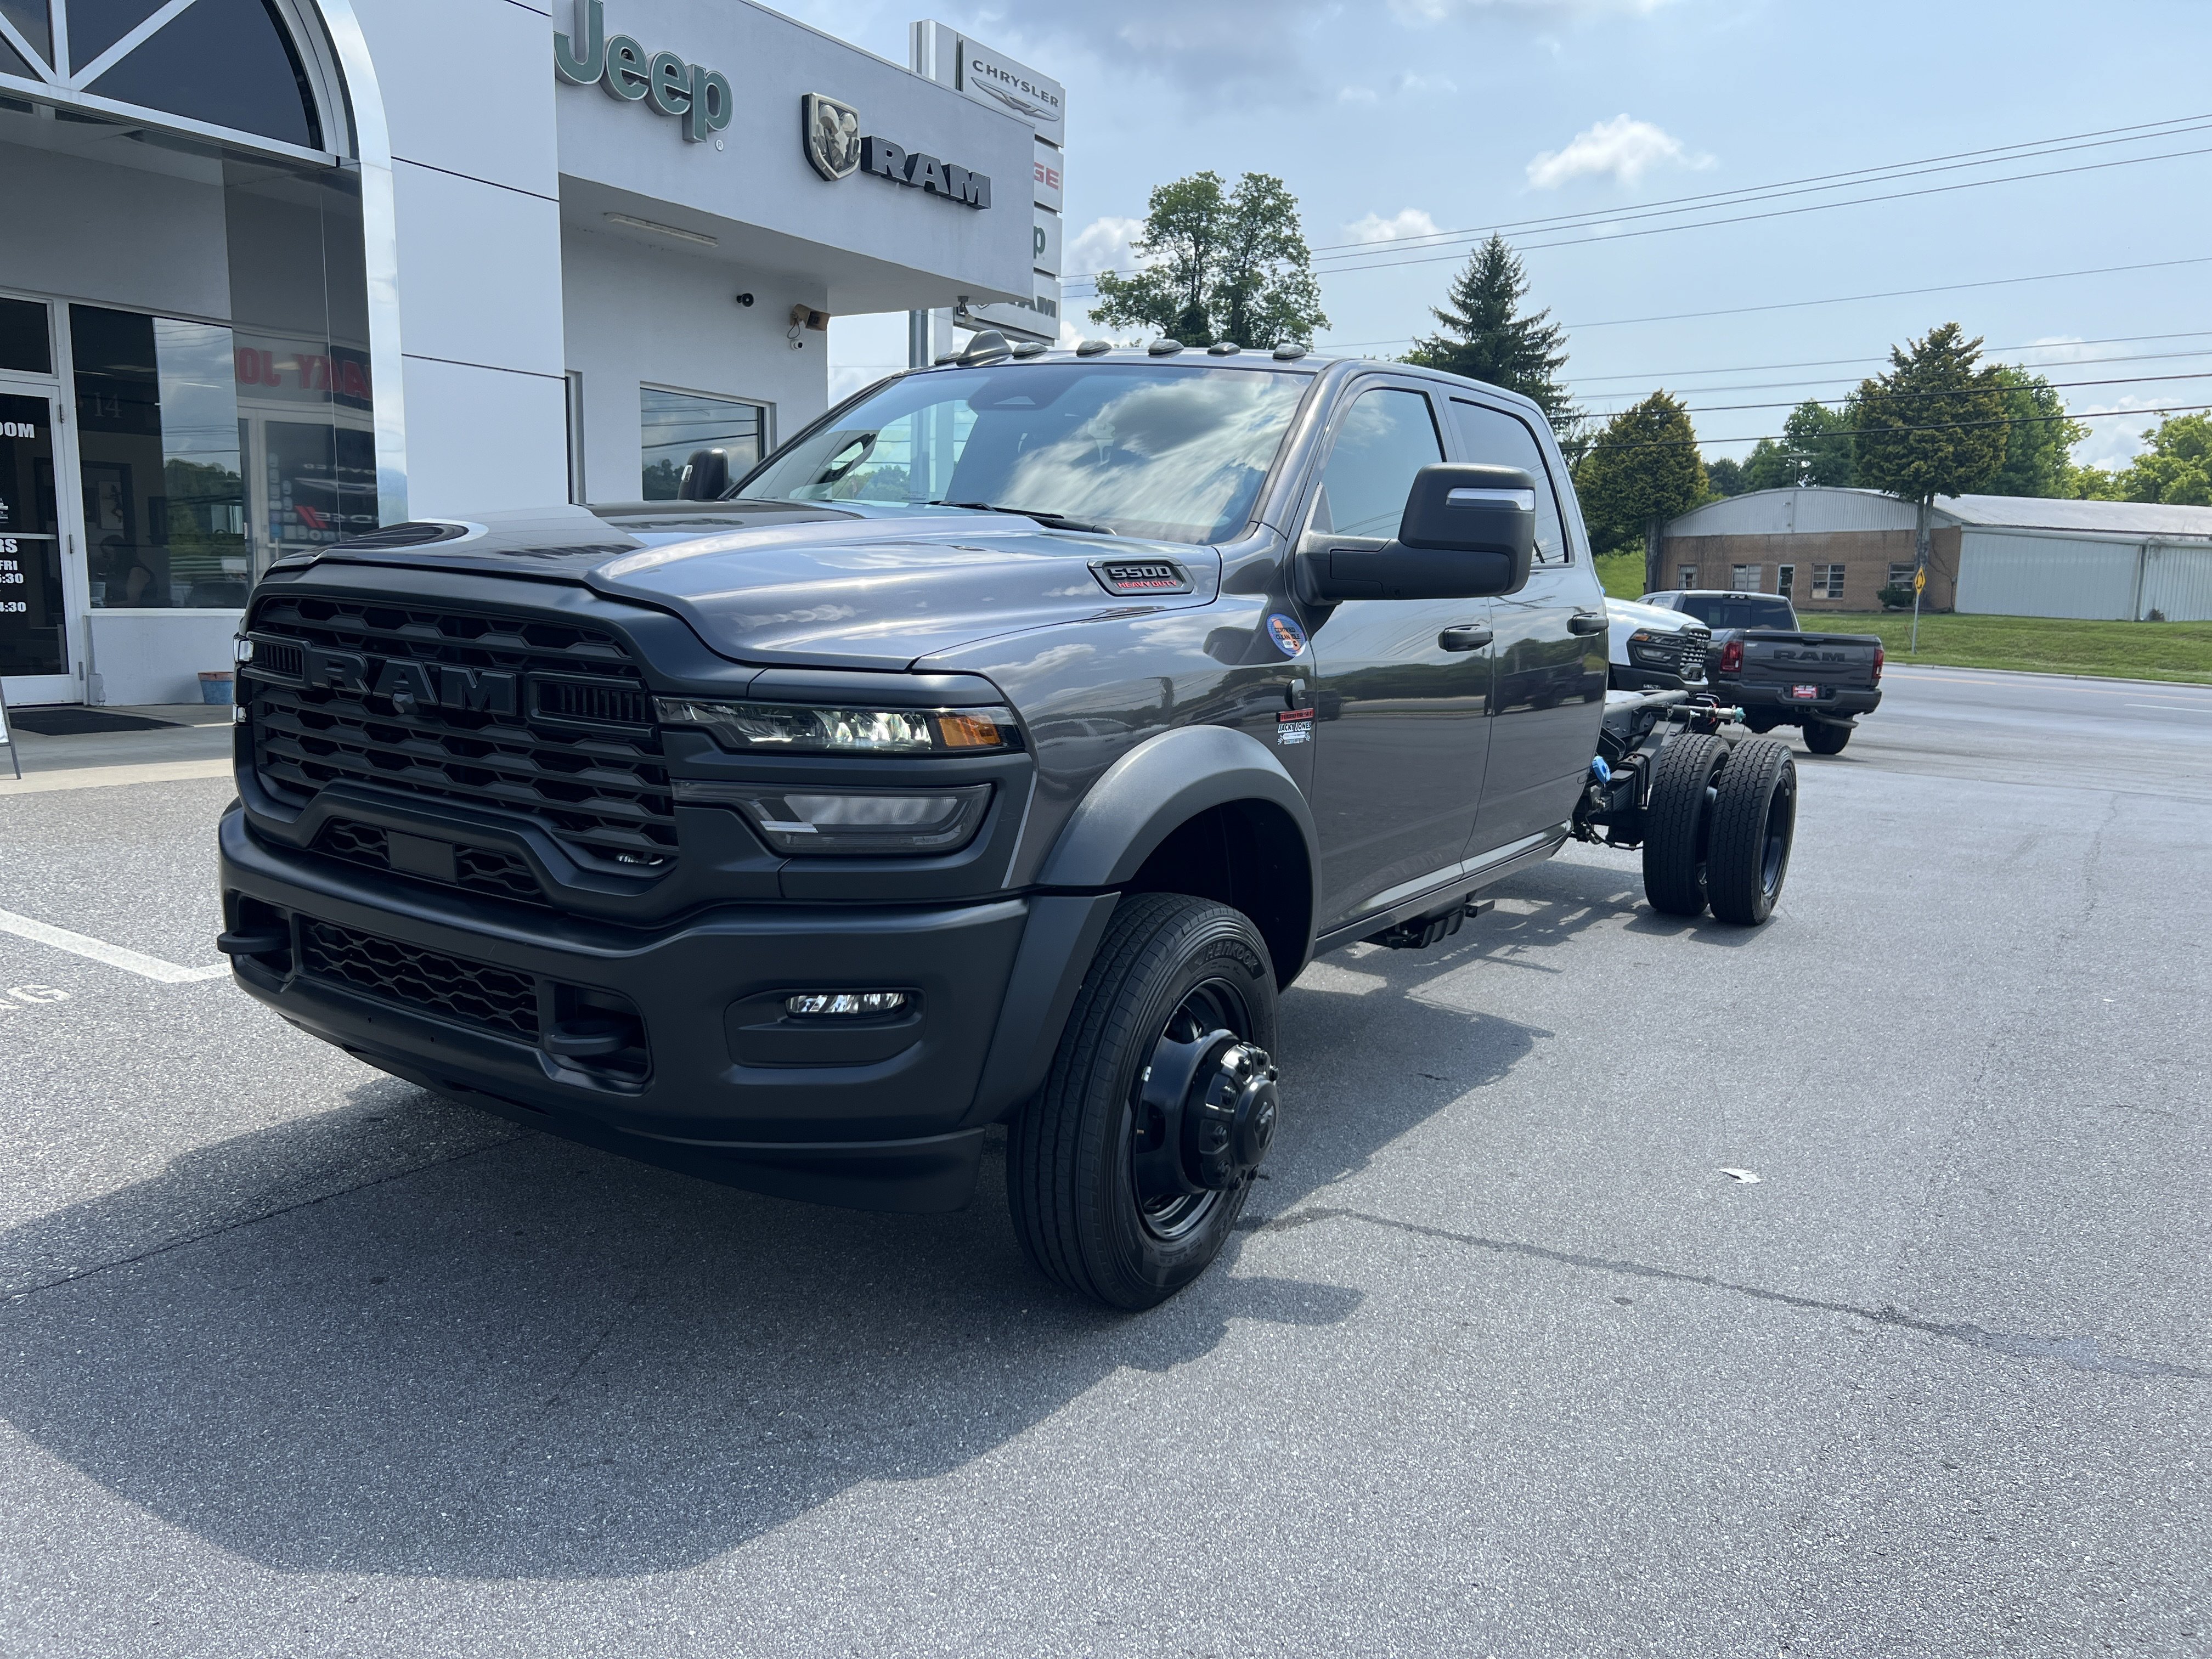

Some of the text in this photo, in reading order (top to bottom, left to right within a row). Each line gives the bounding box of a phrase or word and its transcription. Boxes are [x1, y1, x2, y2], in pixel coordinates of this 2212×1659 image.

[554, 0, 732, 143] Jeep
[973, 60, 1059, 107] CHRYSLER
[861, 136, 991, 210] RAM
[1108, 566, 1172, 579] 5500
[1774, 650, 1845, 662] RAM
[311, 645, 517, 716] RAM
[1278, 721, 1311, 733] JACKY JONES
